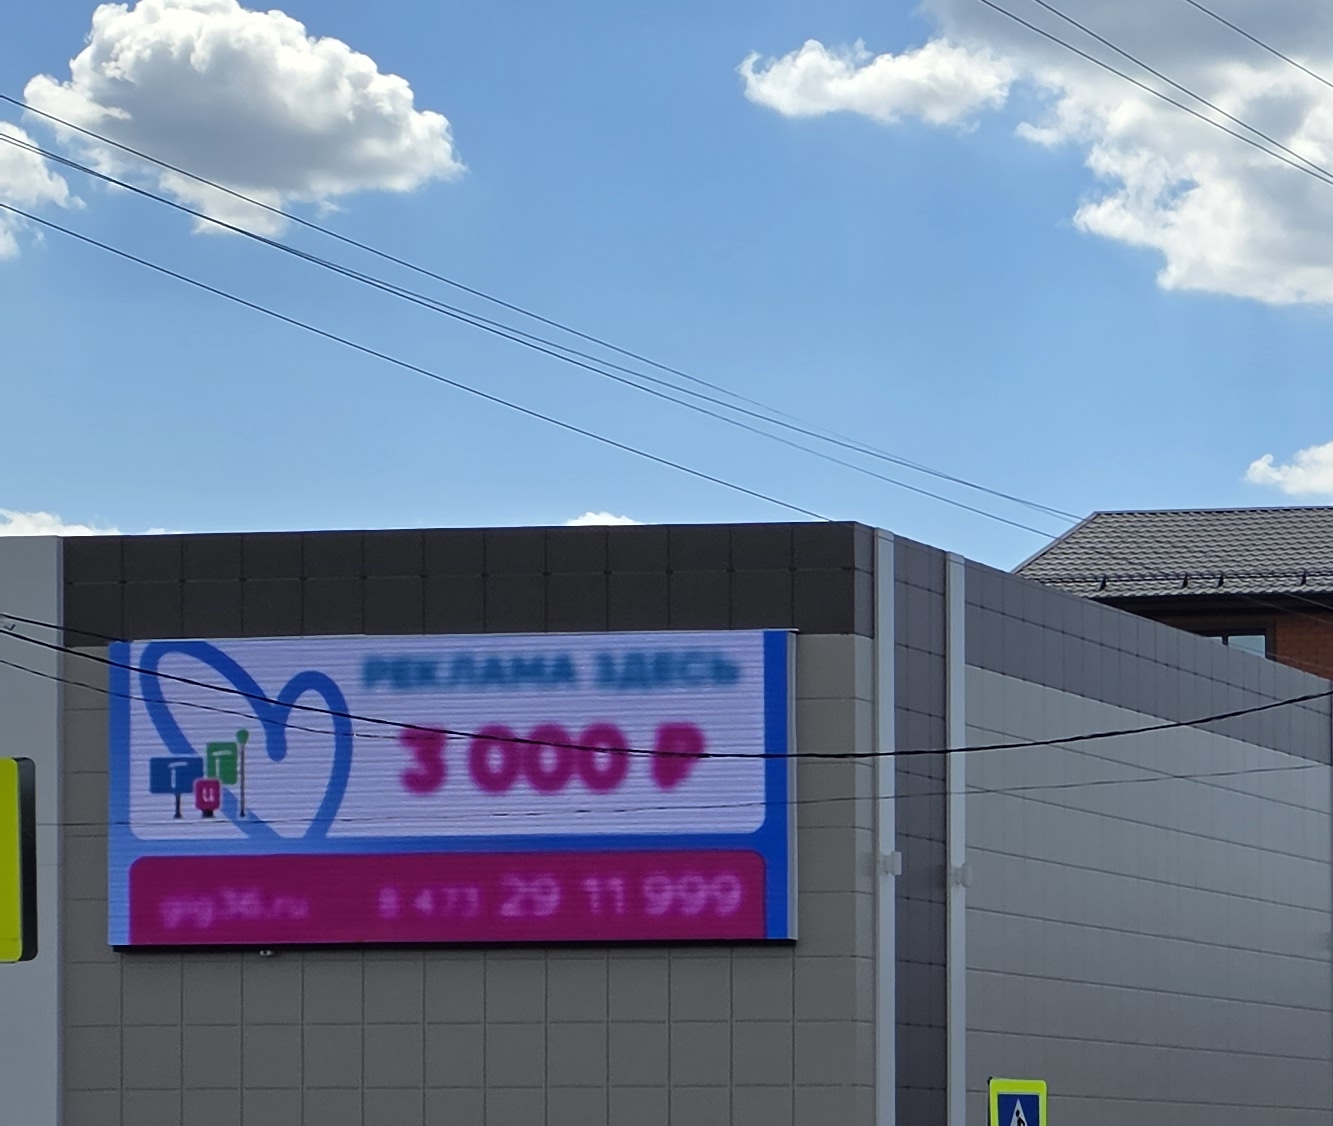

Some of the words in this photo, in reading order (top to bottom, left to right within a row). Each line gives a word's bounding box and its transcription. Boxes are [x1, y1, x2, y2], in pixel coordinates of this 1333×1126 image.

[362, 655, 576, 690] РЕКЛАМА
[596, 652, 740, 688] ЗДЕСЬ
[398, 722, 446, 794] 3
[468, 721, 628, 794] 000
[501, 873, 561, 917] 29
[581, 876, 625, 915] 11
[644, 874, 741, 916] 999
